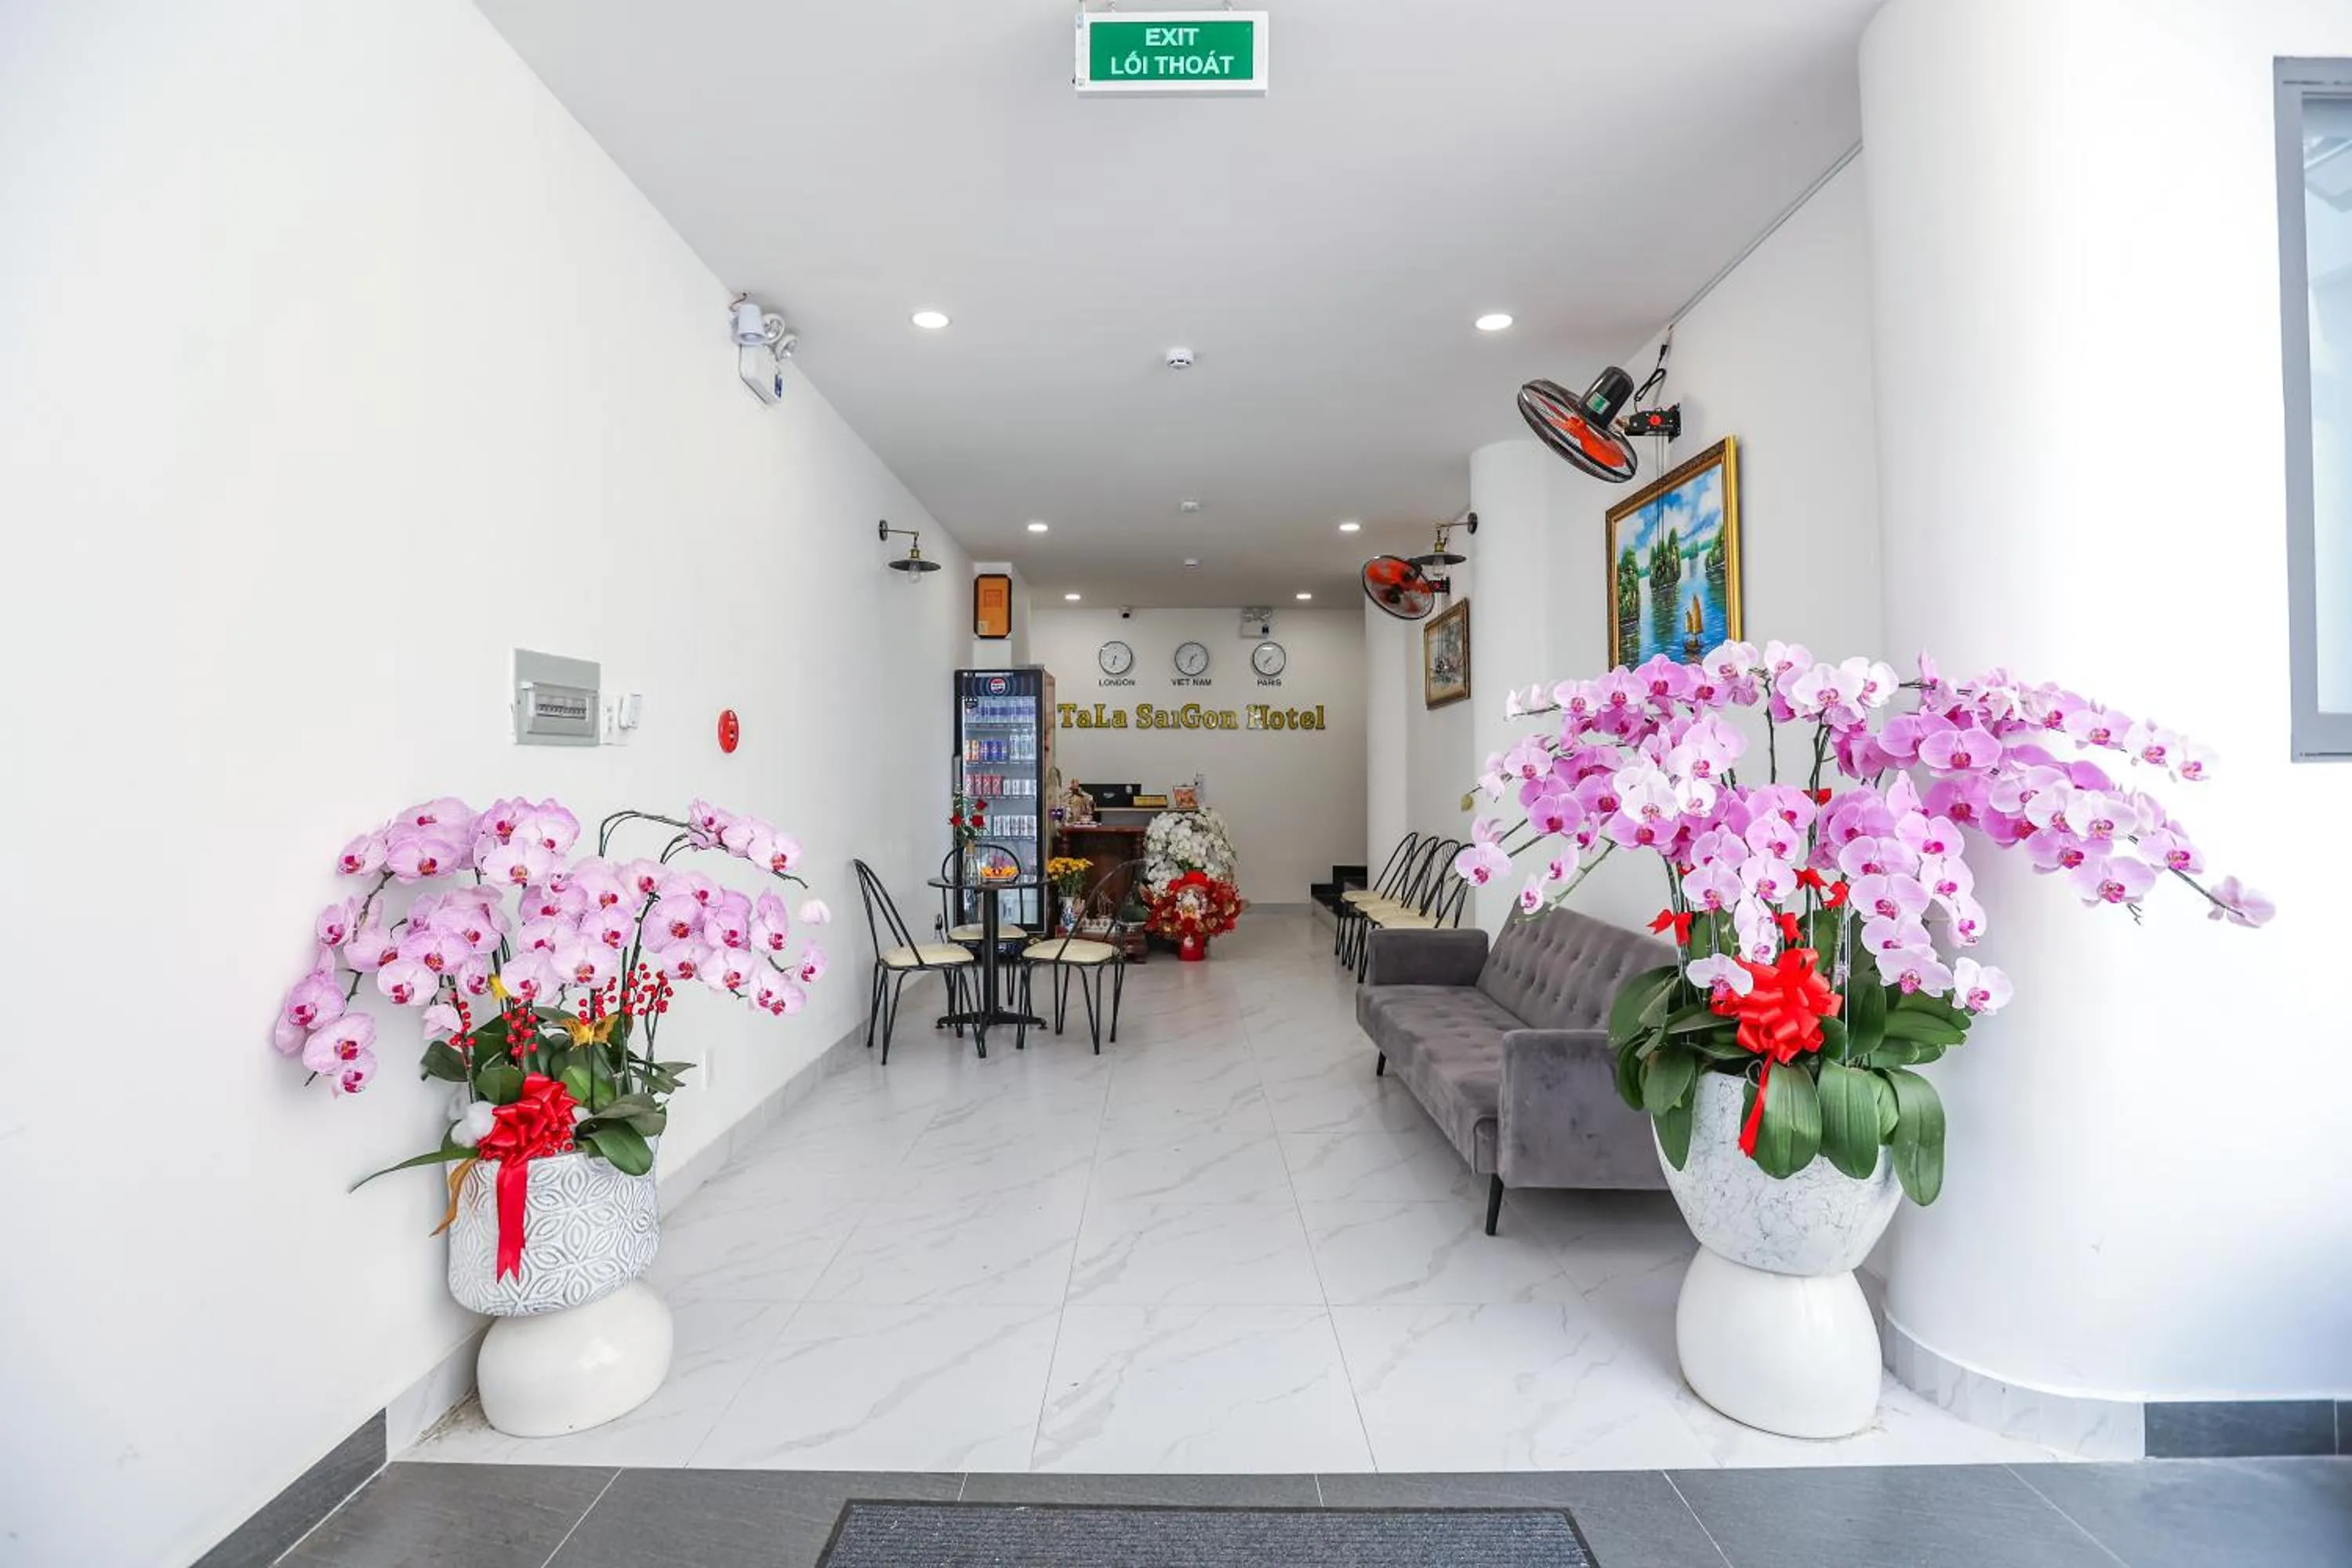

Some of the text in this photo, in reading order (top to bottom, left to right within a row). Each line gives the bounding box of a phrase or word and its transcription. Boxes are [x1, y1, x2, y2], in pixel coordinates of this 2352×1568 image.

[1145, 27, 1200, 46] EXIT
[1111, 51, 1234, 74] LỐI THOÁT
[1057, 703, 1127, 728] TaLa
[1246, 705, 1326, 730] Hotel
